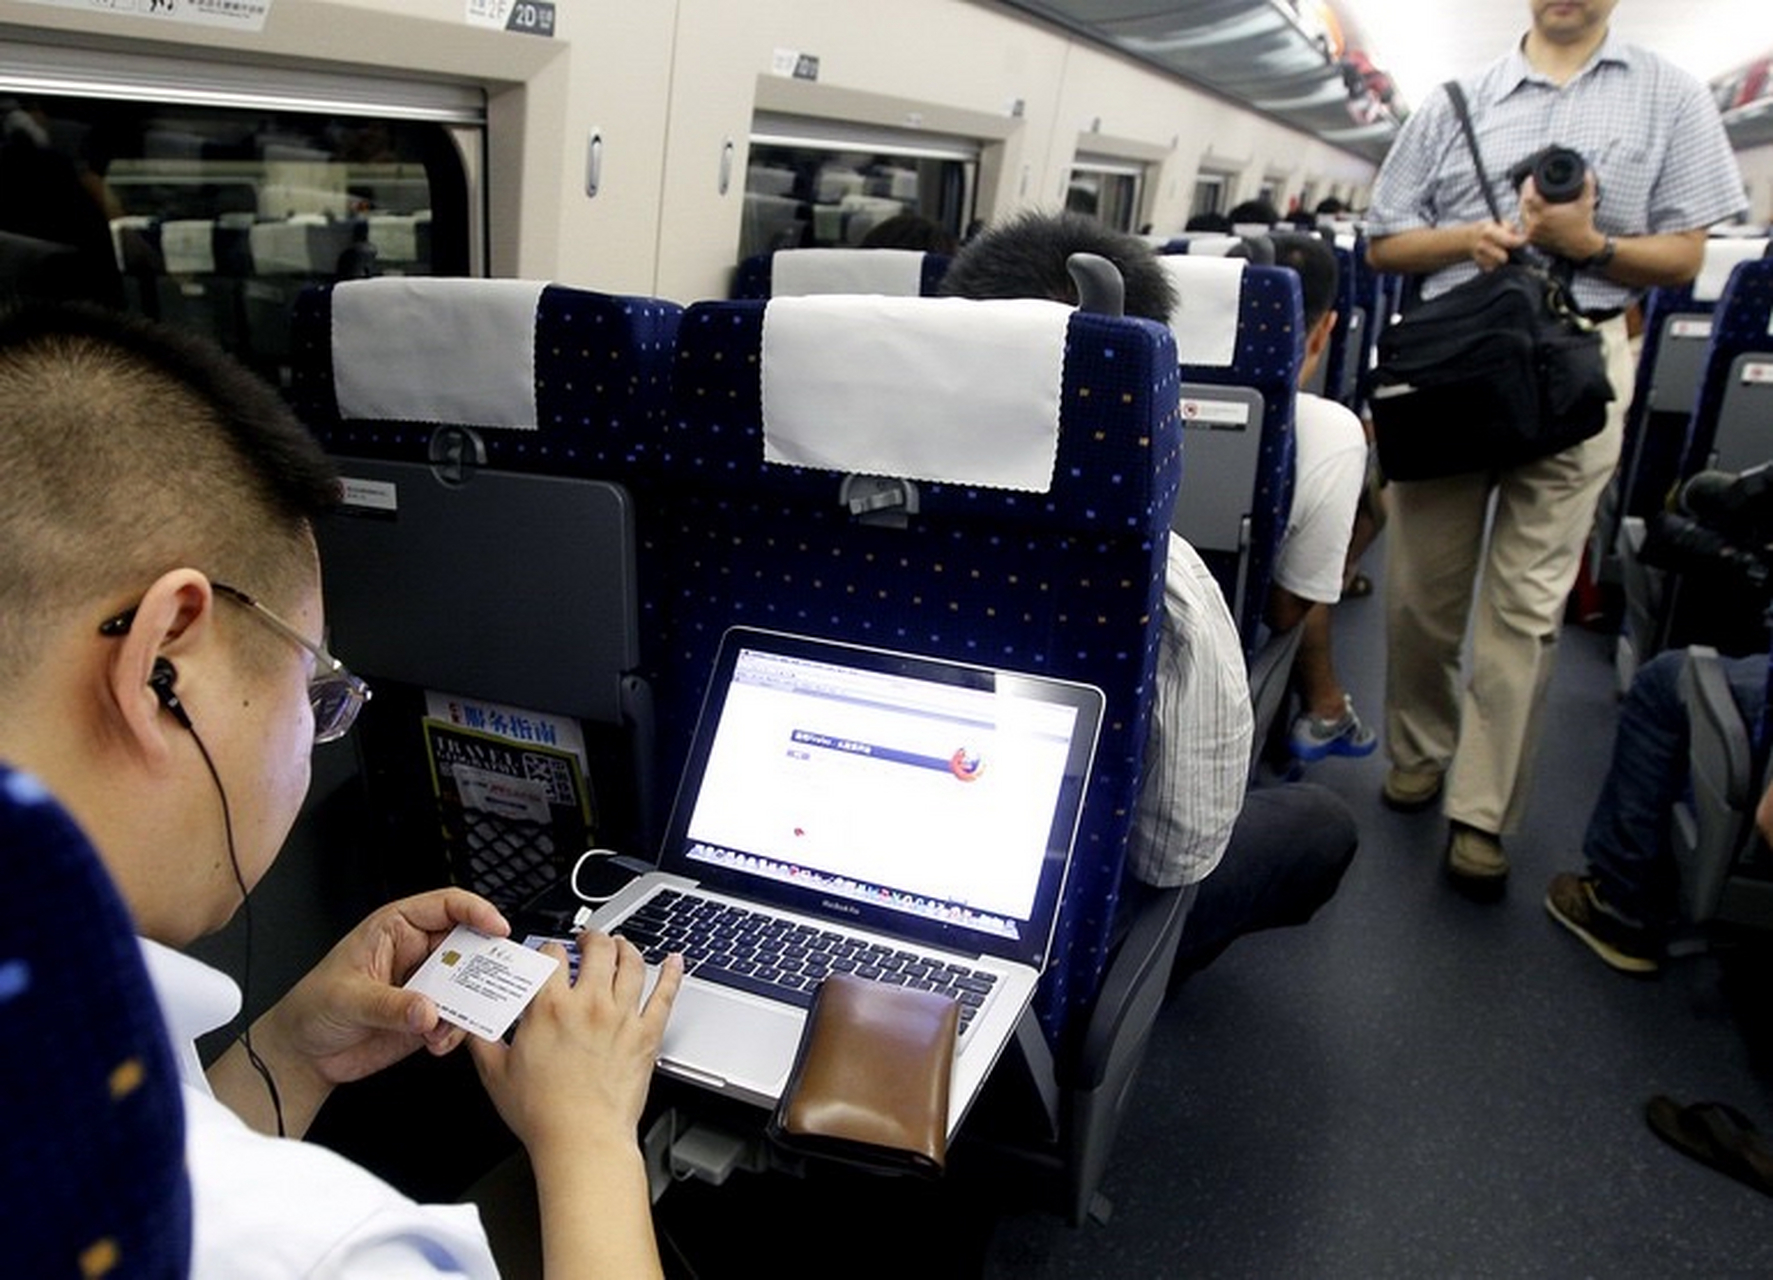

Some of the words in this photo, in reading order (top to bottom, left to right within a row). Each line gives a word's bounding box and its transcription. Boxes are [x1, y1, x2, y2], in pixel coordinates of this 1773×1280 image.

[515, 3, 537, 28] 2D
[463, 705, 557, 746] 服务指南
